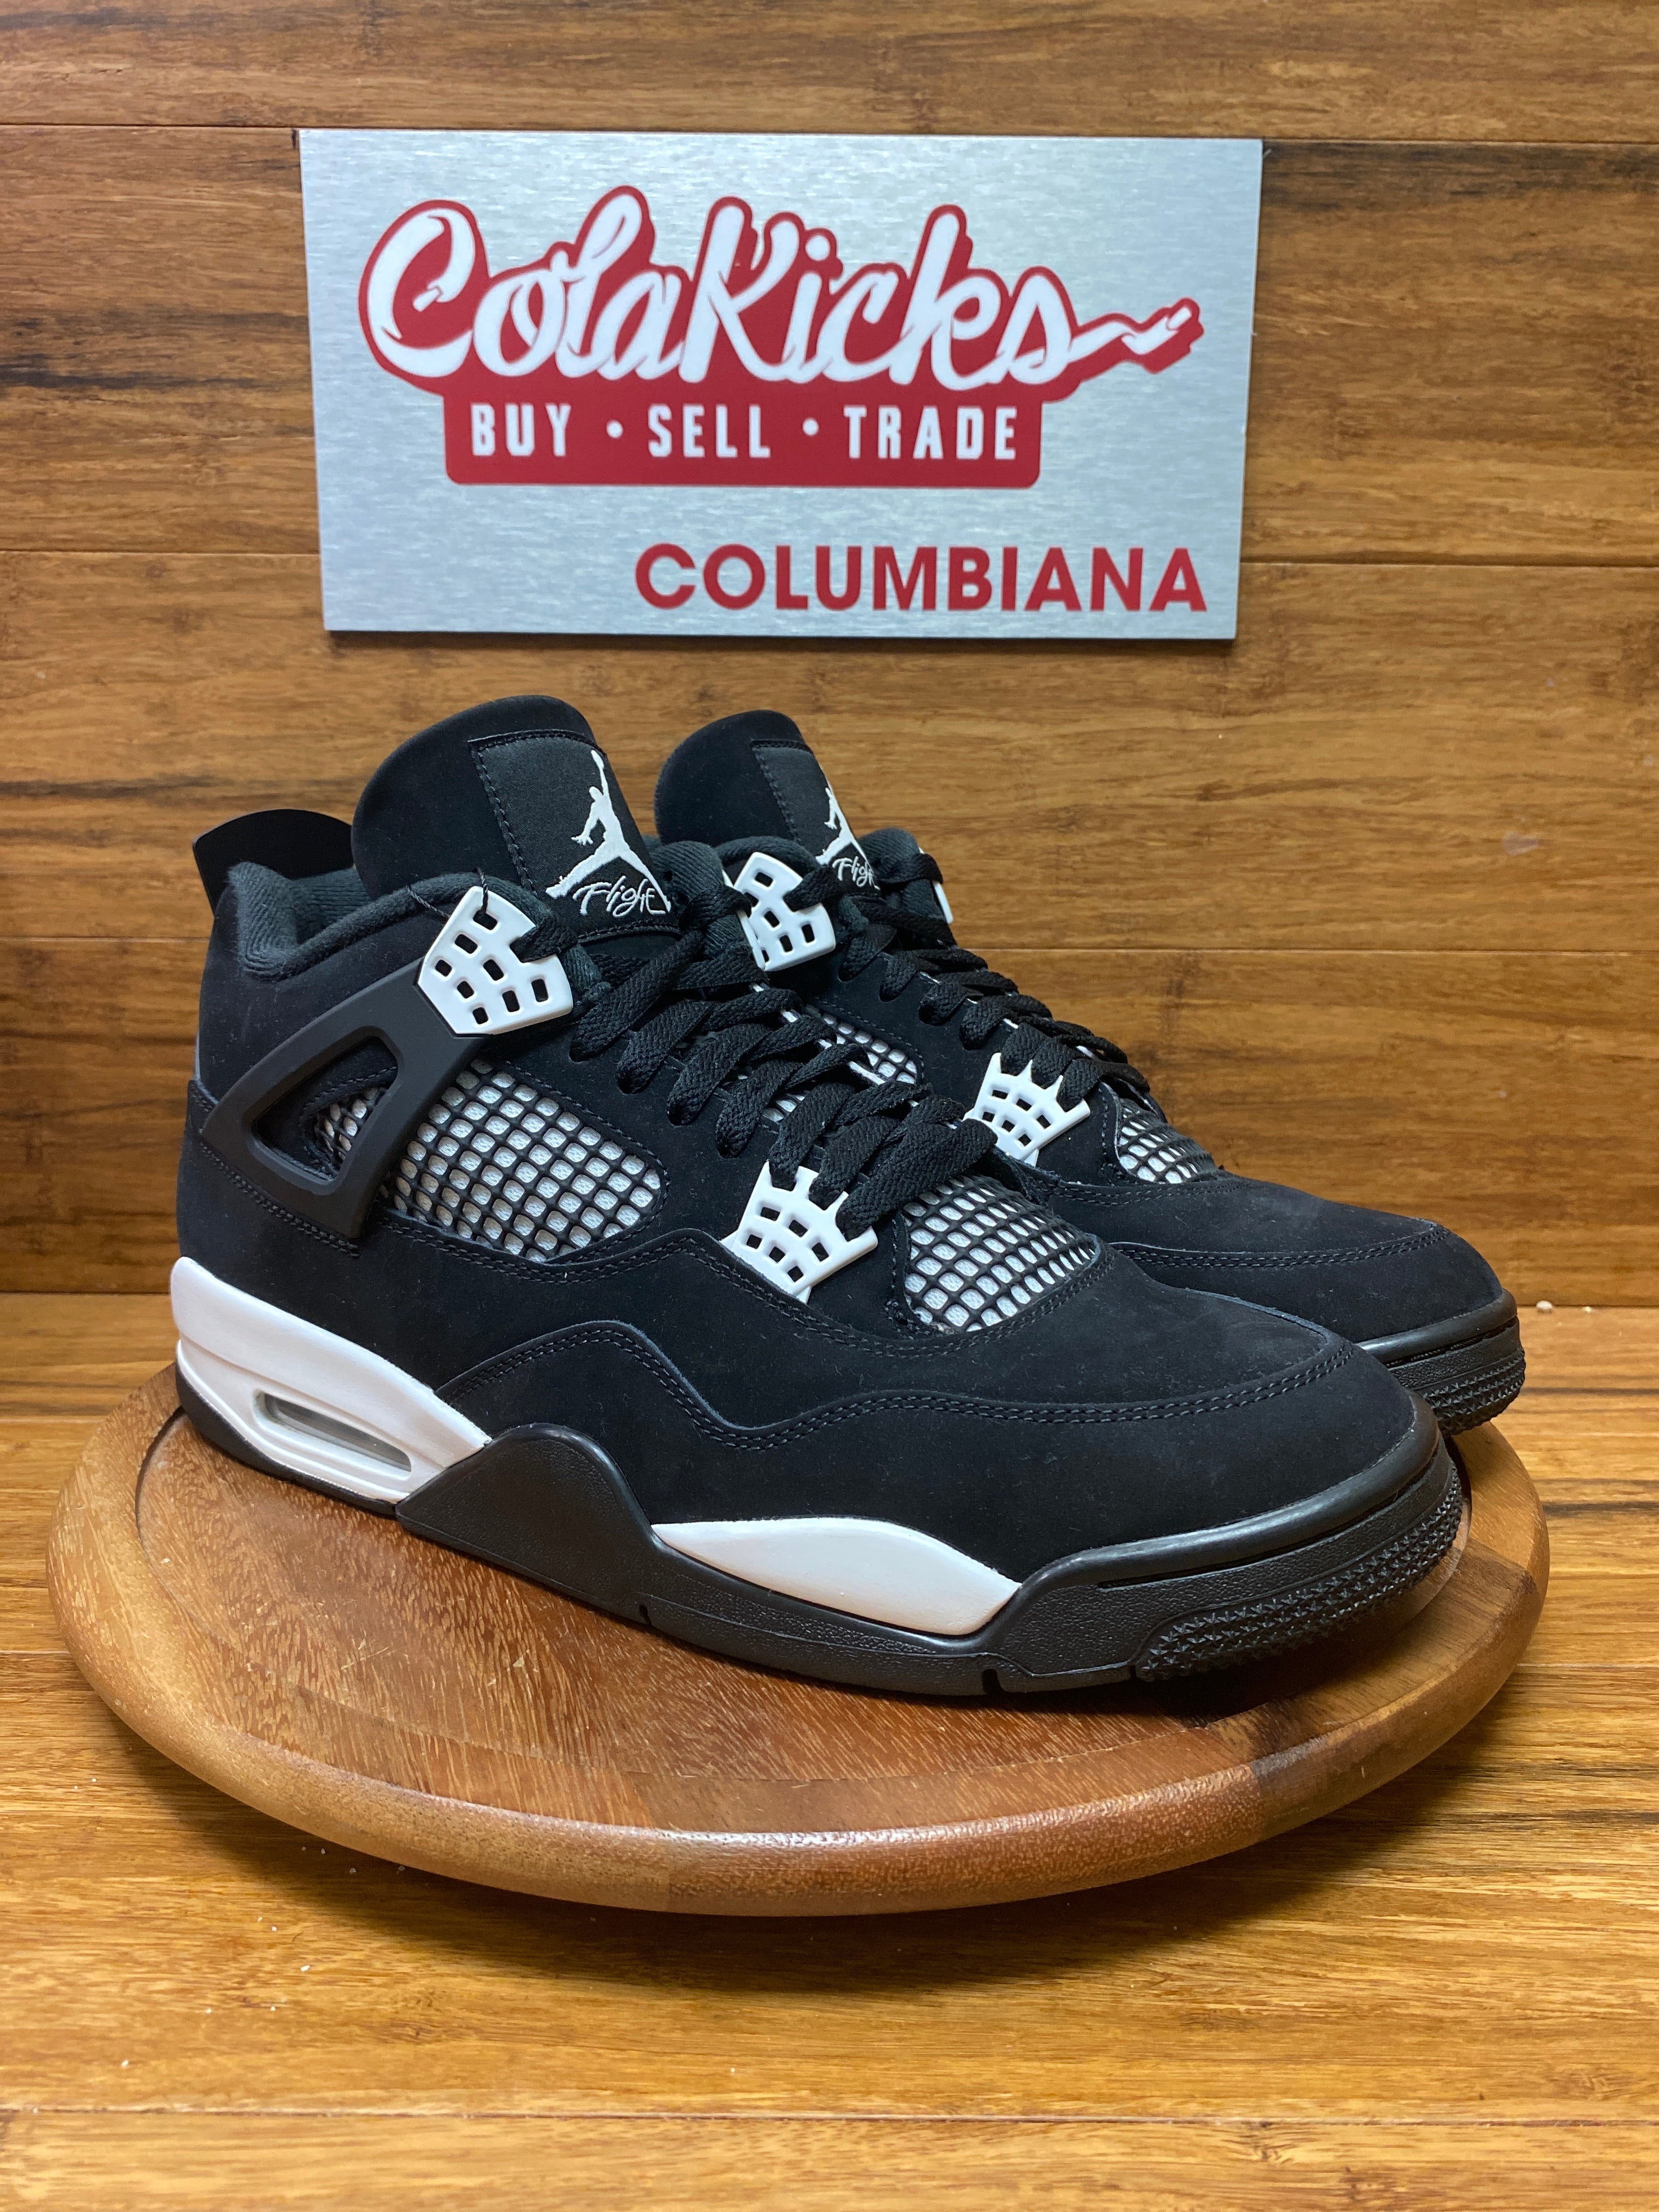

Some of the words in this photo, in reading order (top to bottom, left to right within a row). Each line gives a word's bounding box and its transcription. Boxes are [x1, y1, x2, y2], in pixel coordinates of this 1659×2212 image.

[366, 193, 1193, 391] ColaKicks
[470, 403, 572, 457] BUY
[647, 404, 771, 459] SELL
[843, 405, 1018, 460] TRADE
[635, 543, 1206, 611] COLUMBIANA
[573, 875, 666, 918] Flight
